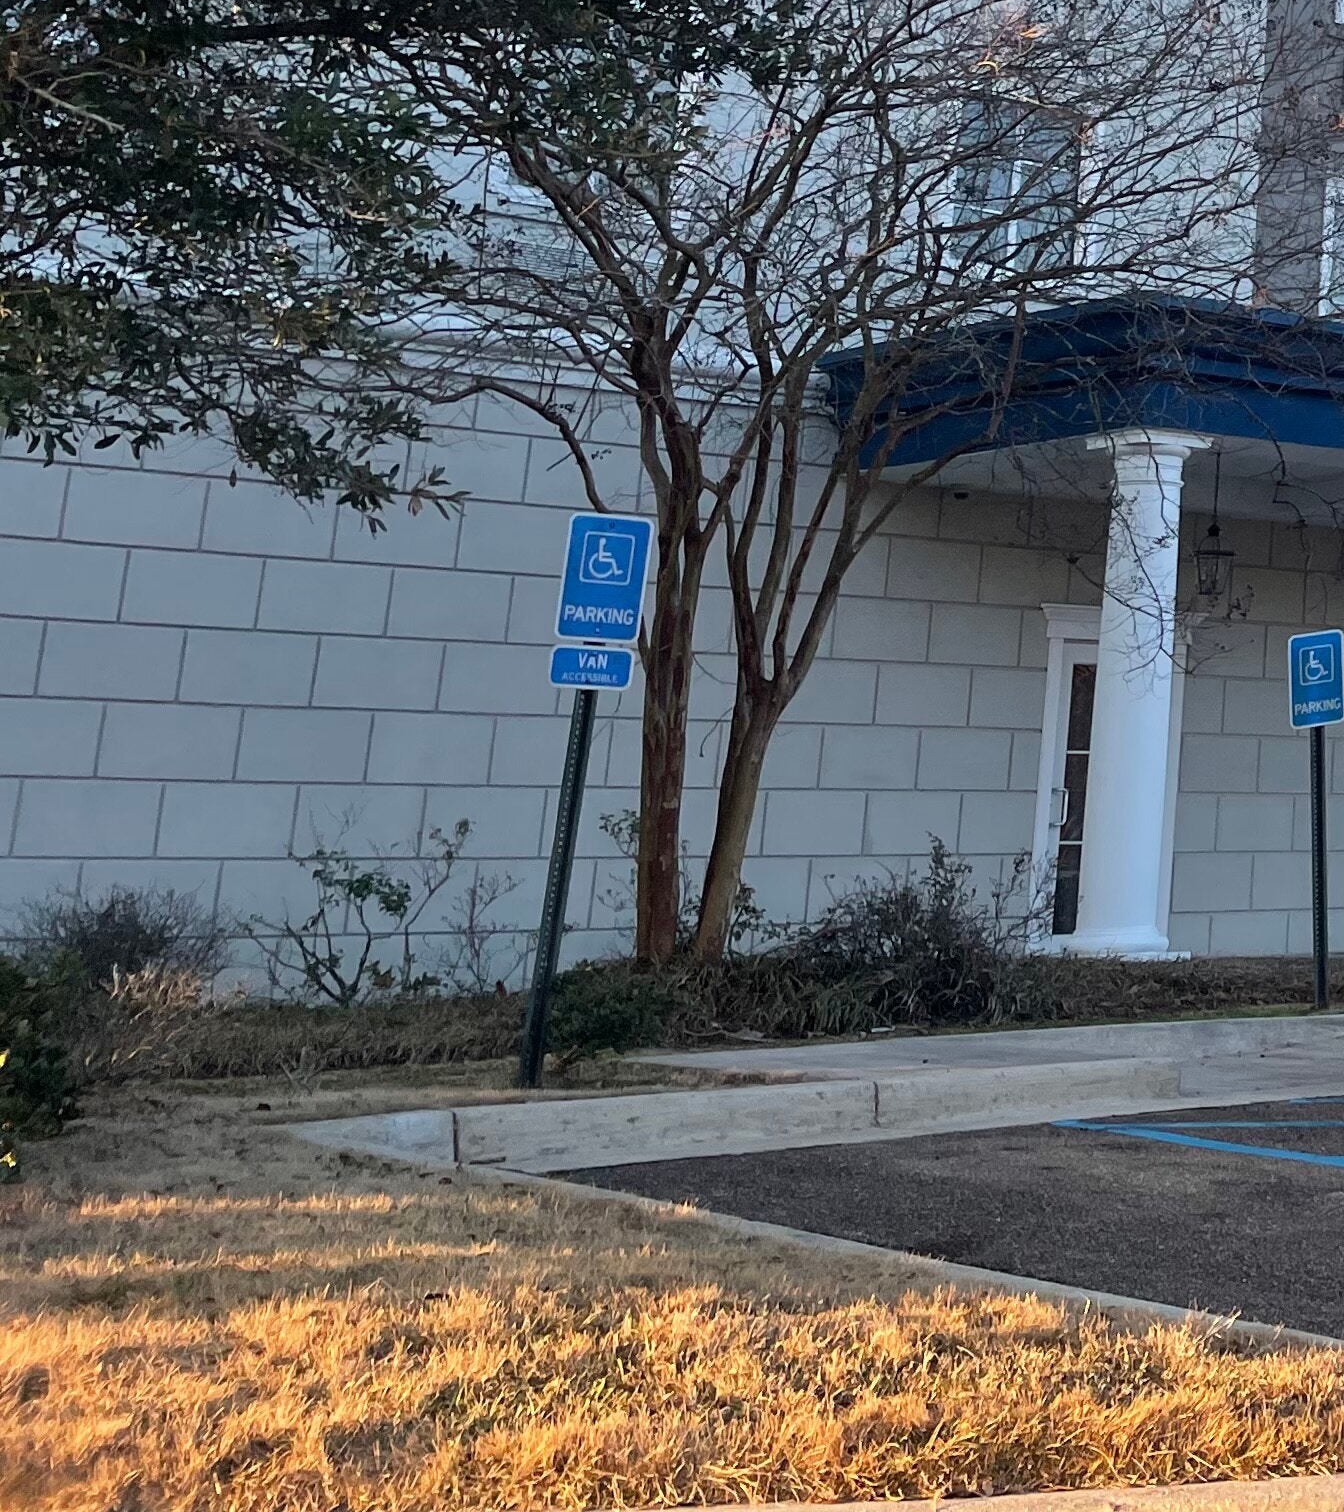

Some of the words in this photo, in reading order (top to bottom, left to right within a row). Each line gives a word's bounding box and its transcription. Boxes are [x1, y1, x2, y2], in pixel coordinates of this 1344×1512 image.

[563, 604, 635, 626] PARKING
[578, 652, 608, 669] VAN
[1294, 697, 1342, 716] PARKING
